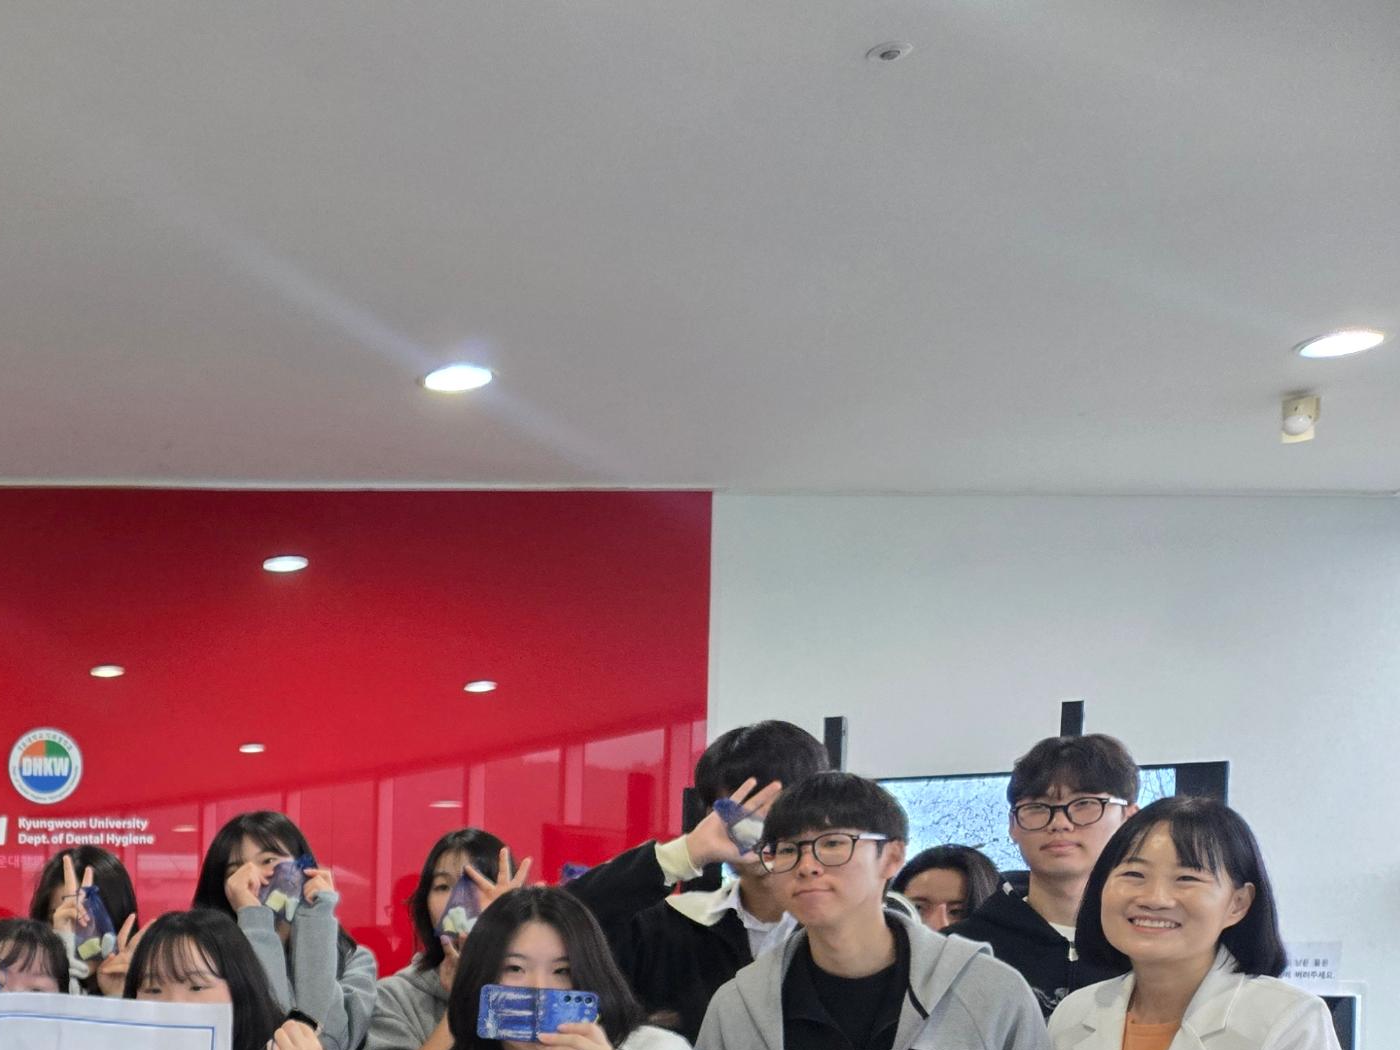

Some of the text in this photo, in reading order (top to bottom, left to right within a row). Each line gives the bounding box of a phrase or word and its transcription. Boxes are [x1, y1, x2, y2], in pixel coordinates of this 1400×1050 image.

[22, 757, 69, 776] DHKW
[18, 817, 148, 831] Kyungwoon University
[18, 833, 154, 847] Dept. of Dental Hygiene
